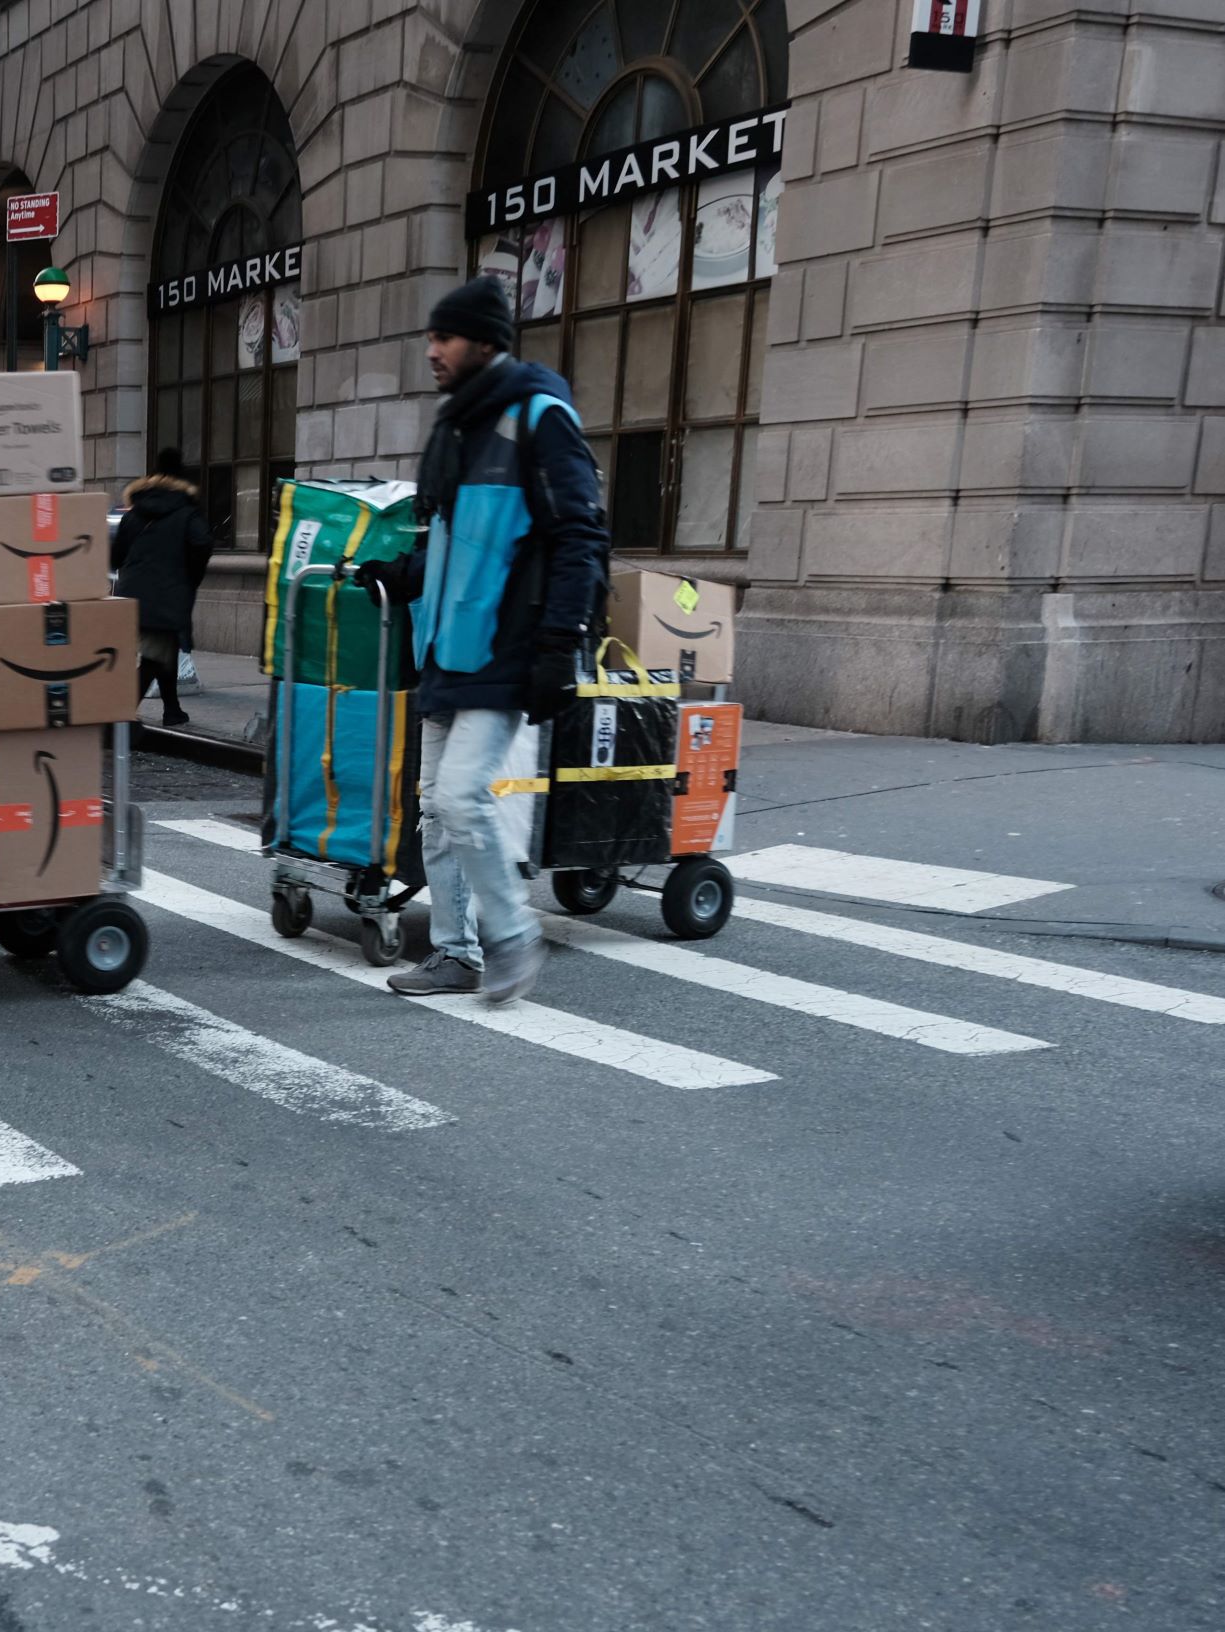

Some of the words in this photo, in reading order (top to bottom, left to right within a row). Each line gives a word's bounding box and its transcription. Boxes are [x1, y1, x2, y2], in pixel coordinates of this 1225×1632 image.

[487, 175, 556, 226] 150
[578, 110, 788, 203] MARKET
[10, 201, 20, 210] NO
[20, 197, 50, 210] STANDING
[10, 210, 36, 222] Anytime
[158, 275, 196, 309] 150
[207, 246, 301, 297] MARKE
